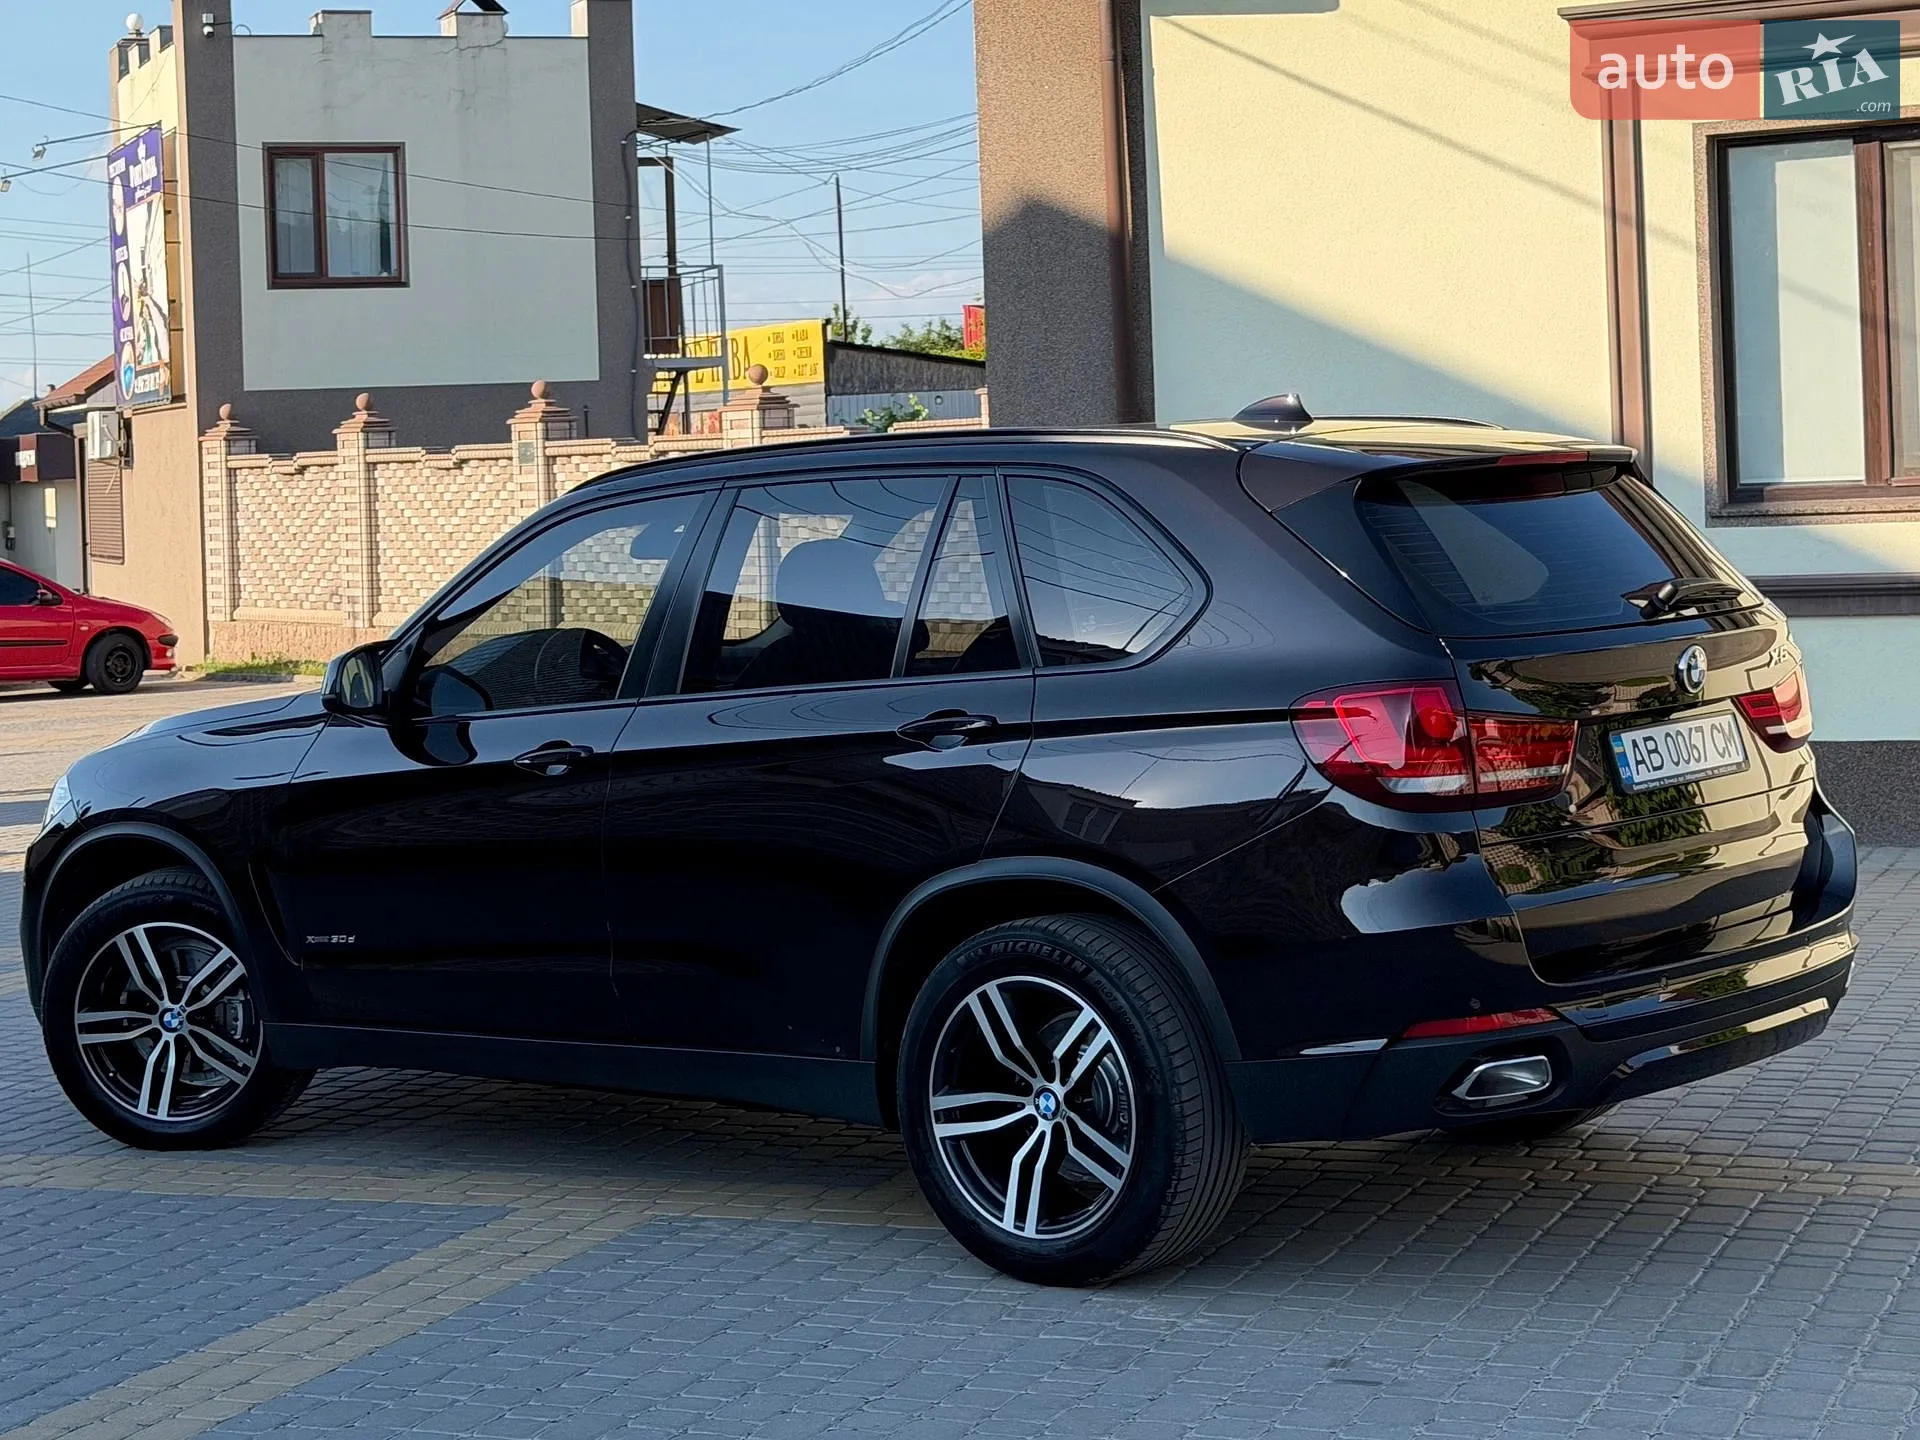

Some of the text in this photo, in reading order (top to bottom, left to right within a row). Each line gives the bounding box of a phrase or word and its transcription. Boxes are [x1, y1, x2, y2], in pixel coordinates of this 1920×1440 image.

[1631, 719, 1740, 776] AB 0067 CM
[991, 941, 1088, 974] MICHELIN
